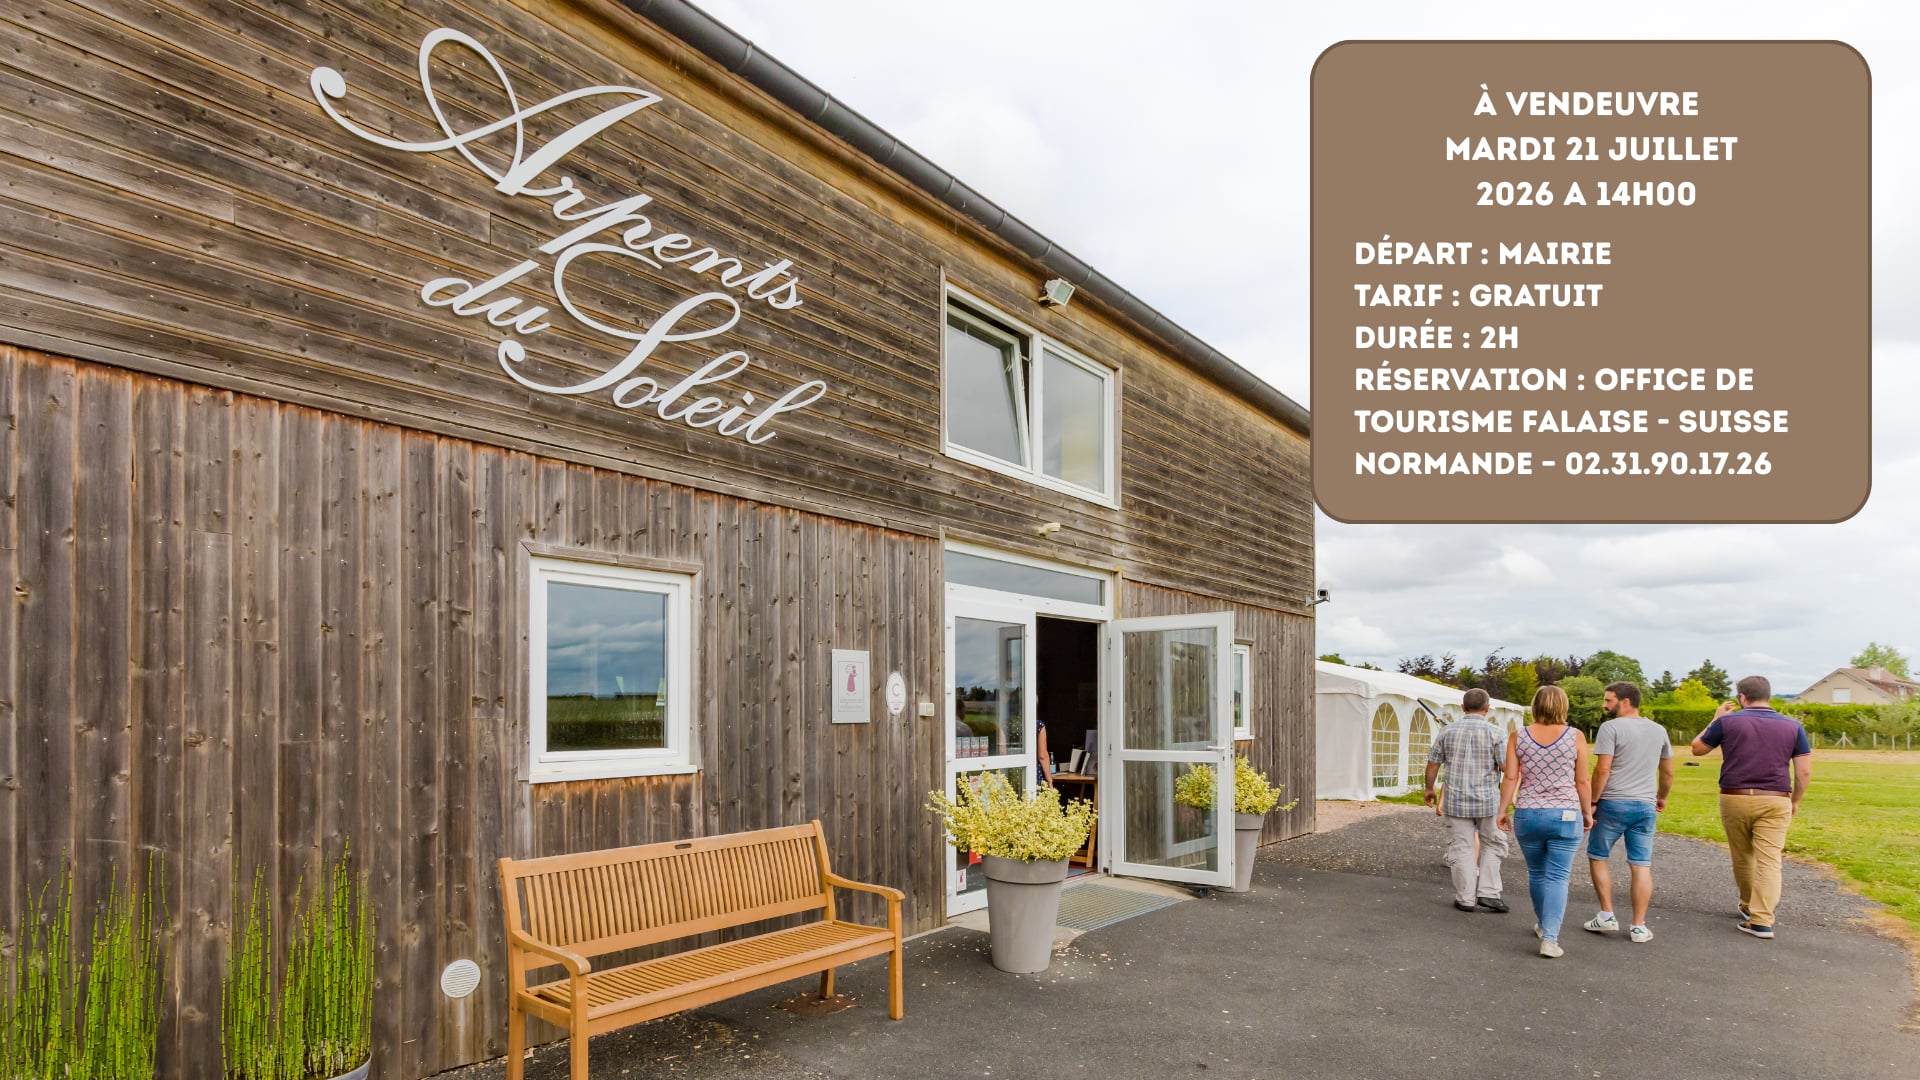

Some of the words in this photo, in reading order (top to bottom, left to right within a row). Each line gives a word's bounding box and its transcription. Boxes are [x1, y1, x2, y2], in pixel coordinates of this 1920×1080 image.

[310, 28, 803, 310] Arpents
[421, 260, 551, 334] du
[498, 242, 827, 444] Soleil
